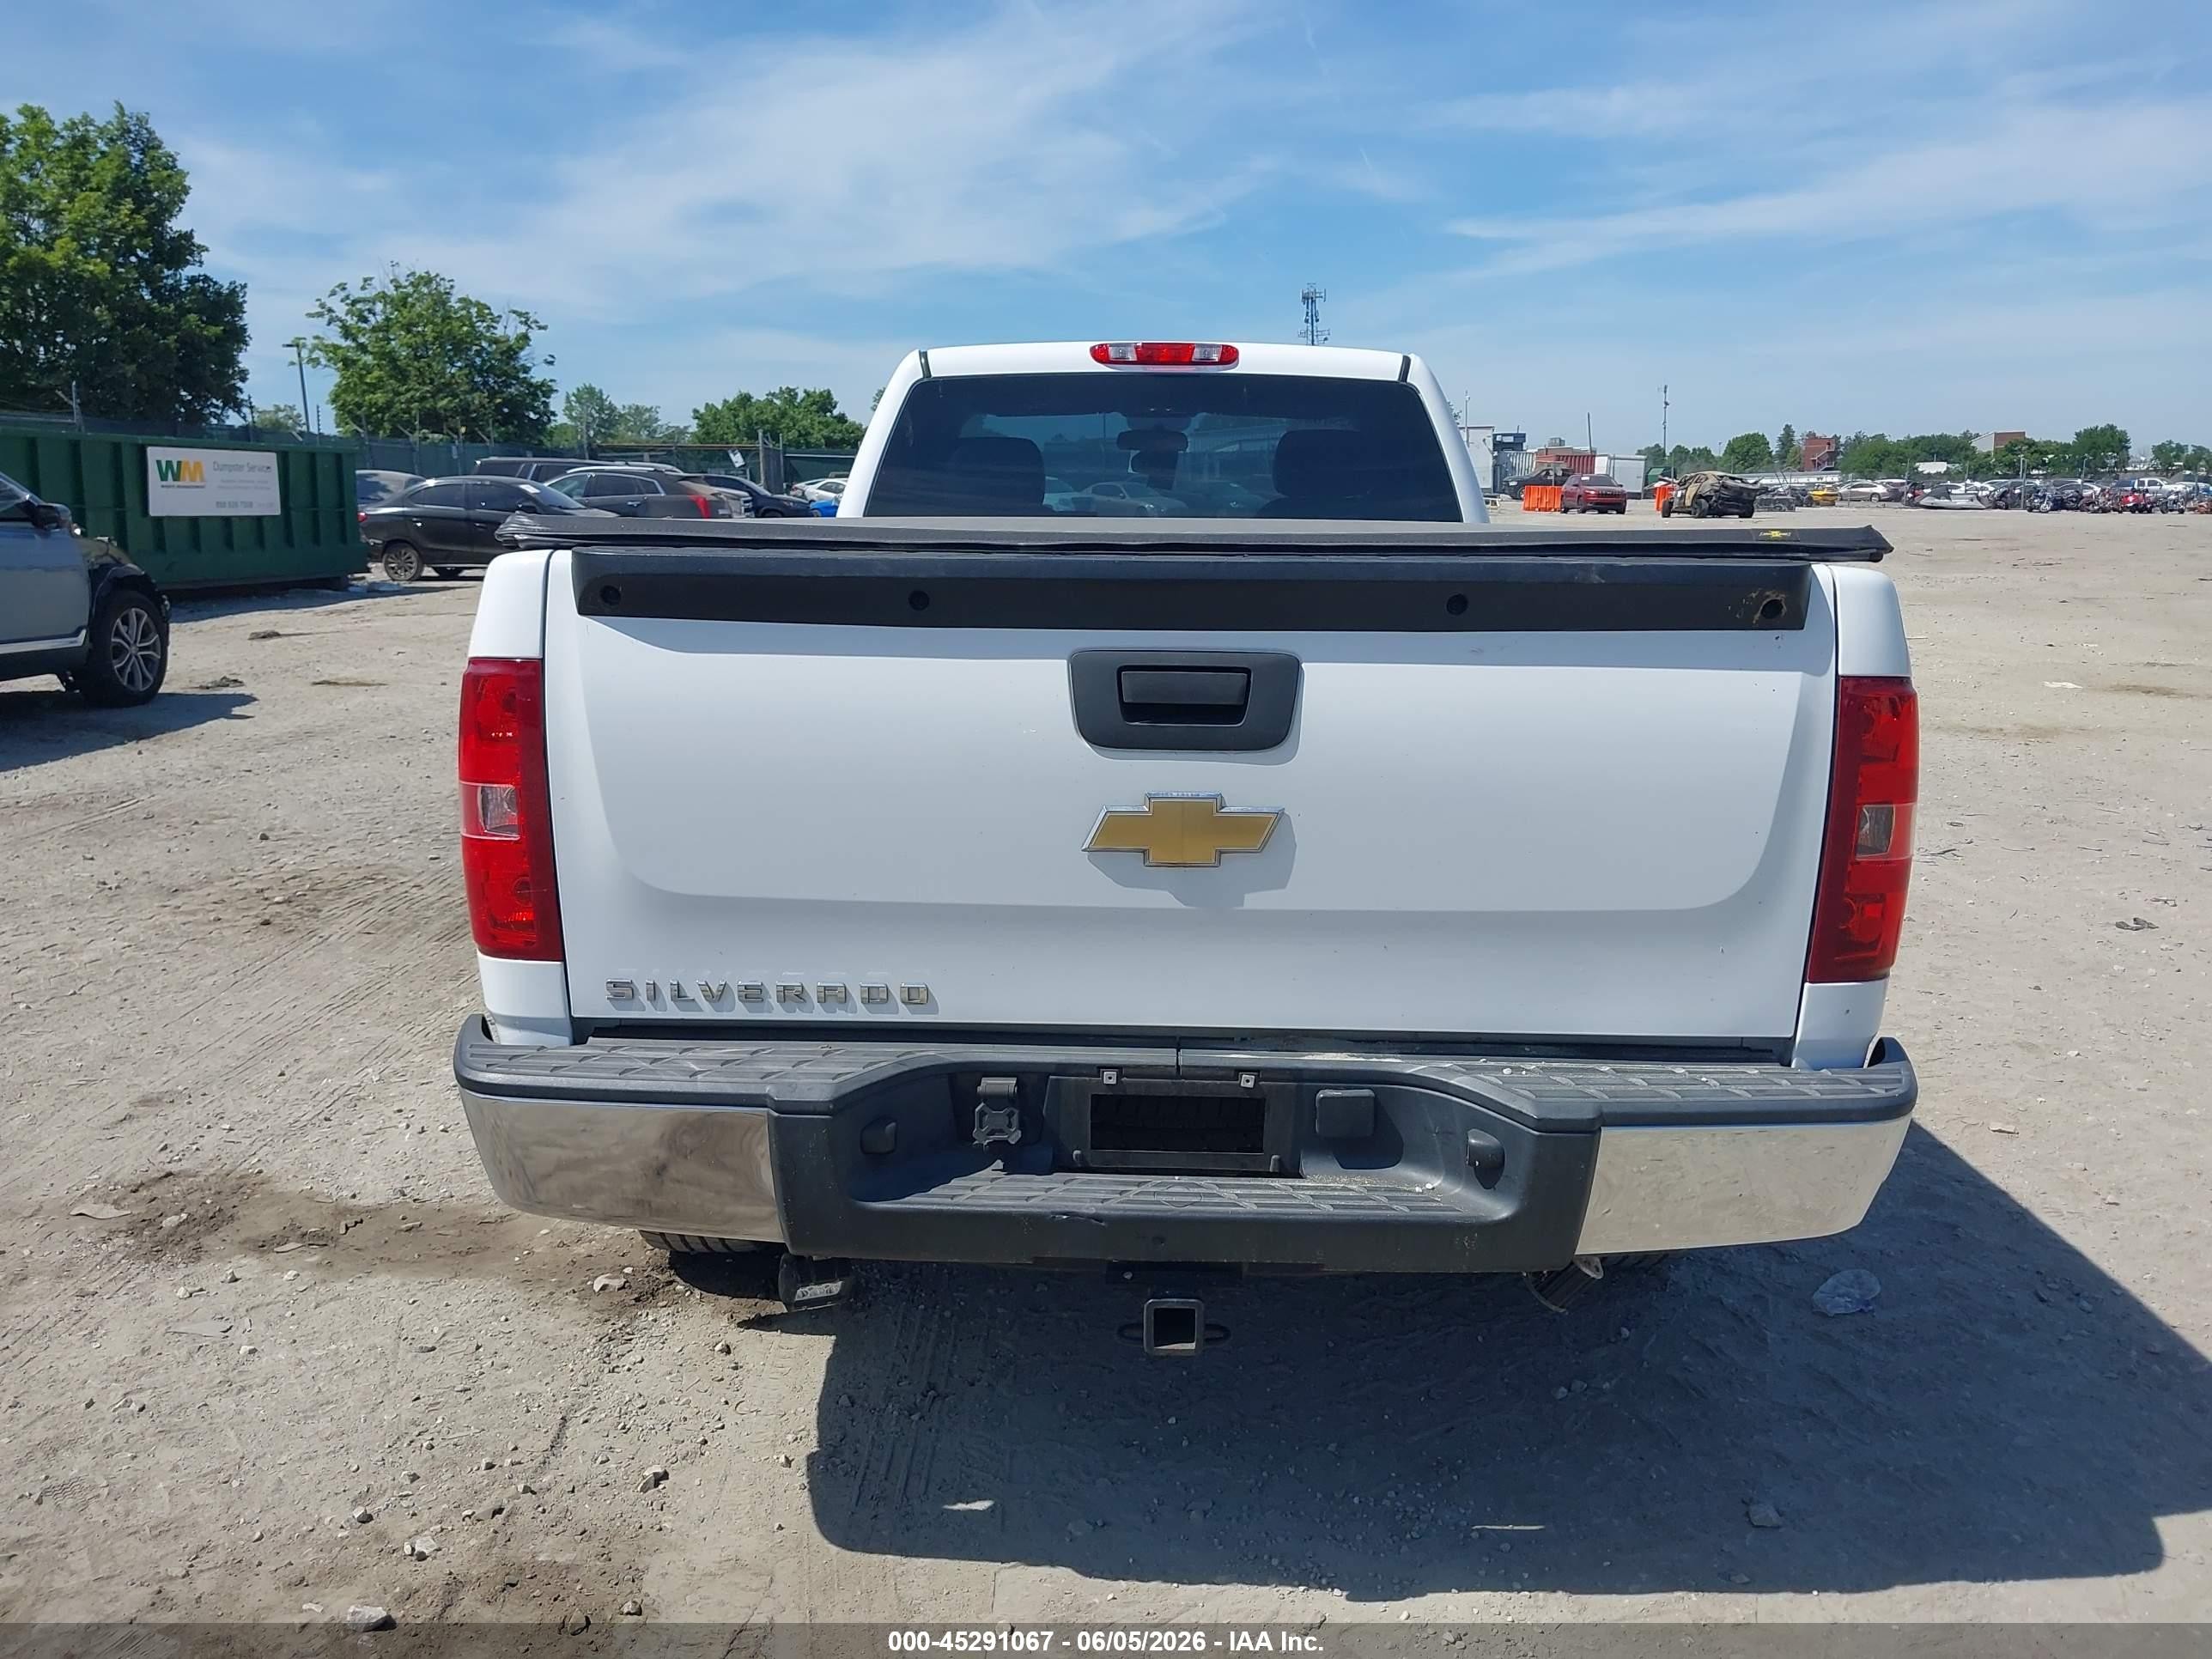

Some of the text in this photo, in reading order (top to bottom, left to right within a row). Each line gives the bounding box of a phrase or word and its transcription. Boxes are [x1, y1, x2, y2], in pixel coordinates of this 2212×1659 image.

[155, 459, 204, 482] WM
[213, 461, 245, 473] Dumpster
[605, 978, 930, 1005] SILVERADO
